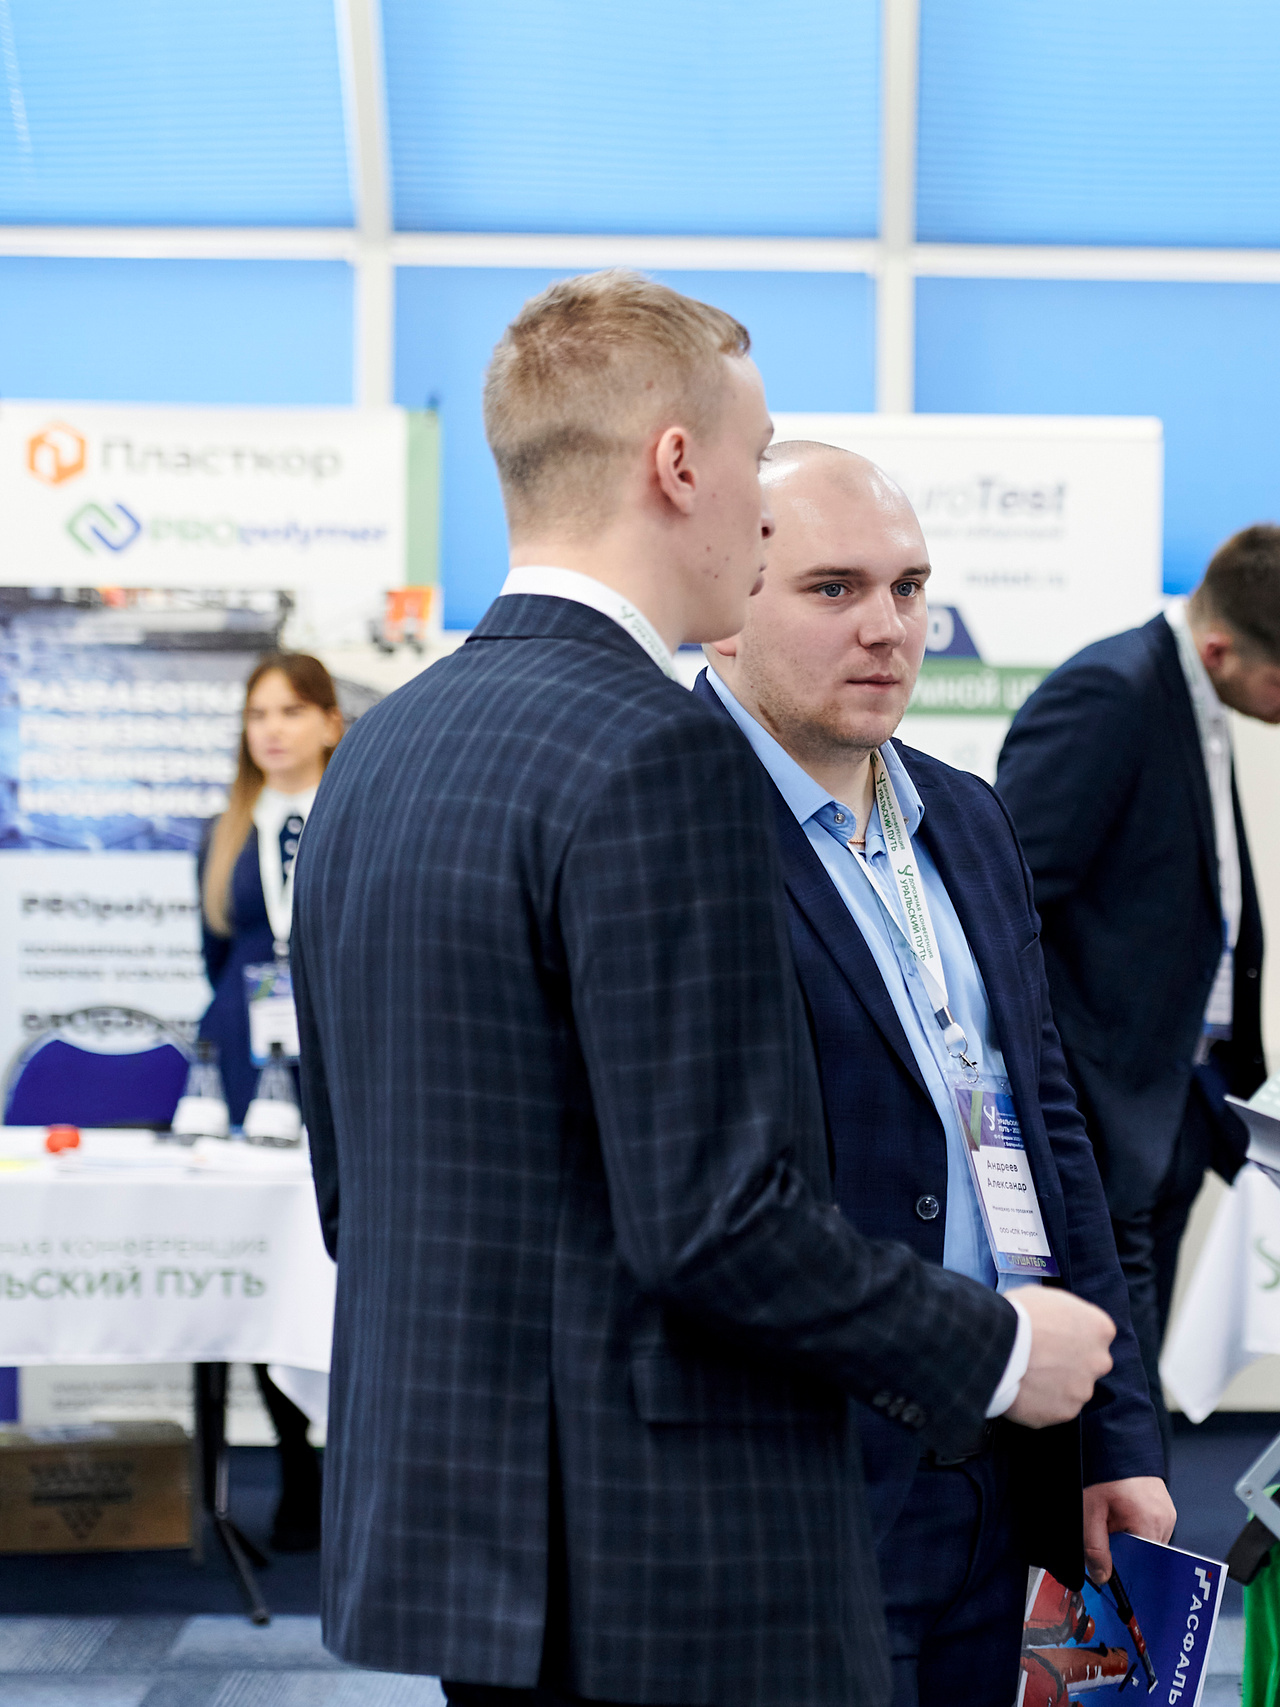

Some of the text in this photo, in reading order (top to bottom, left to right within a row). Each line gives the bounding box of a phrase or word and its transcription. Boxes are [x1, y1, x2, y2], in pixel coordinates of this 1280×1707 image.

[101, 438, 342, 484] Пласткор
[877, 786, 898, 852] УРАЛЬСКИЙ ПУТЬ
[900, 879, 927, 961] УРАЛЬСКИЙ ПУТЬ
[908, 877, 934, 959] ДОРОЖНАЯ КОНФЕРЕНЦИЯ
[986, 1160, 1019, 1173] Андреев
[987, 1178, 1027, 1193] Александр
[60, 1238, 271, 1260] КОНФЕРЕНЦИЯ
[1006, 1254, 1047, 1268] СЛУШАТЕЛЬ
[0, 1260, 267, 1300] ЬСКИЙ ПУТЬ
[1168, 1593, 1203, 1706] АСФАЛЬ
